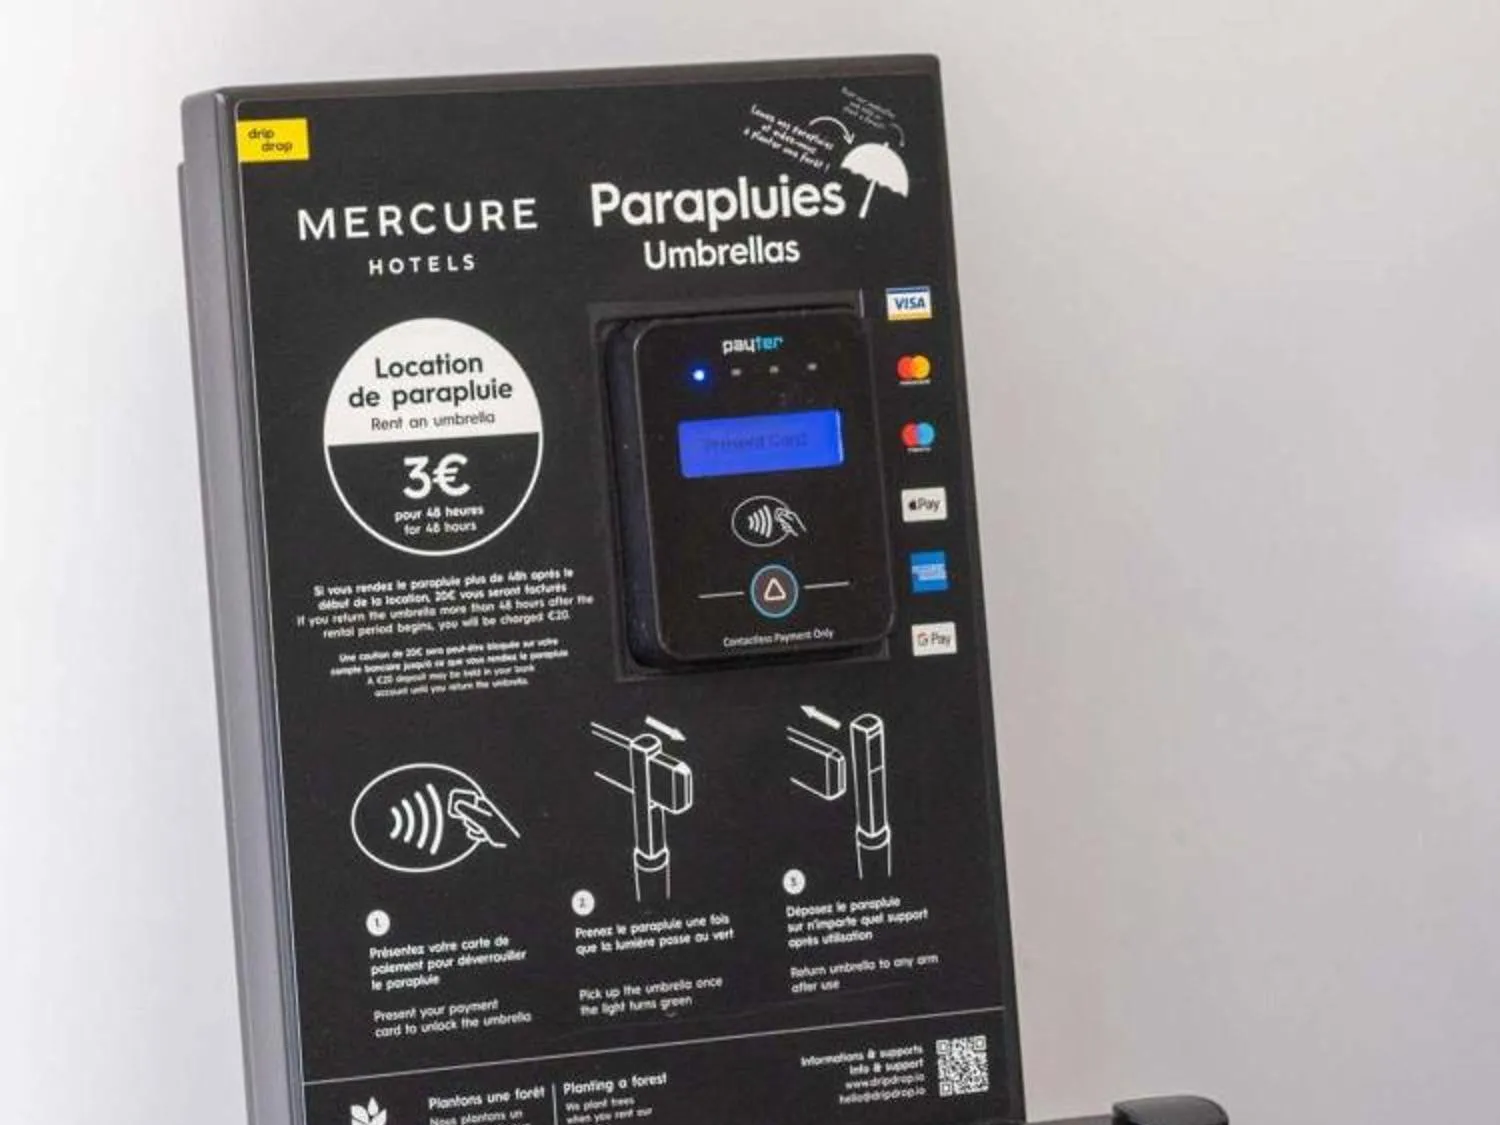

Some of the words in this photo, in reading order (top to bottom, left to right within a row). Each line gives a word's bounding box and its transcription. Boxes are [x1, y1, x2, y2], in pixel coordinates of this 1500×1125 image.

[247, 128, 274, 140] drip
[261, 140, 293, 153] drop
[592, 175, 845, 232] Parapluies
[298, 198, 537, 240] MERCURE
[644, 235, 800, 269] Umbrellas
[369, 253, 474, 275] HOTELS
[894, 297, 925, 310] VISA
[722, 337, 782, 355] payter
[375, 353, 483, 379] Location
[349, 386, 380, 408] de
[392, 378, 512, 410] parapluie
[371, 416, 403, 431] Rent
[409, 417, 428, 429] an
[433, 410, 495, 427] umbrella
[404, 453, 469, 499] 3€
[395, 510, 422, 522] pour
[427, 506, 441, 518] 48
[445, 506, 484, 517] heures
[918, 498, 941, 512] Pay
[404, 524, 421, 535] for
[426, 521, 440, 533] 48
[444, 521, 476, 532] hours
[563, 1079, 614, 1095] Planting
[618, 1078, 627, 1089] a
[632, 1072, 667, 1087] forest
[428, 1094, 482, 1110] Plantons
[487, 1091, 510, 1103] une
[515, 1086, 544, 1100] forêt
